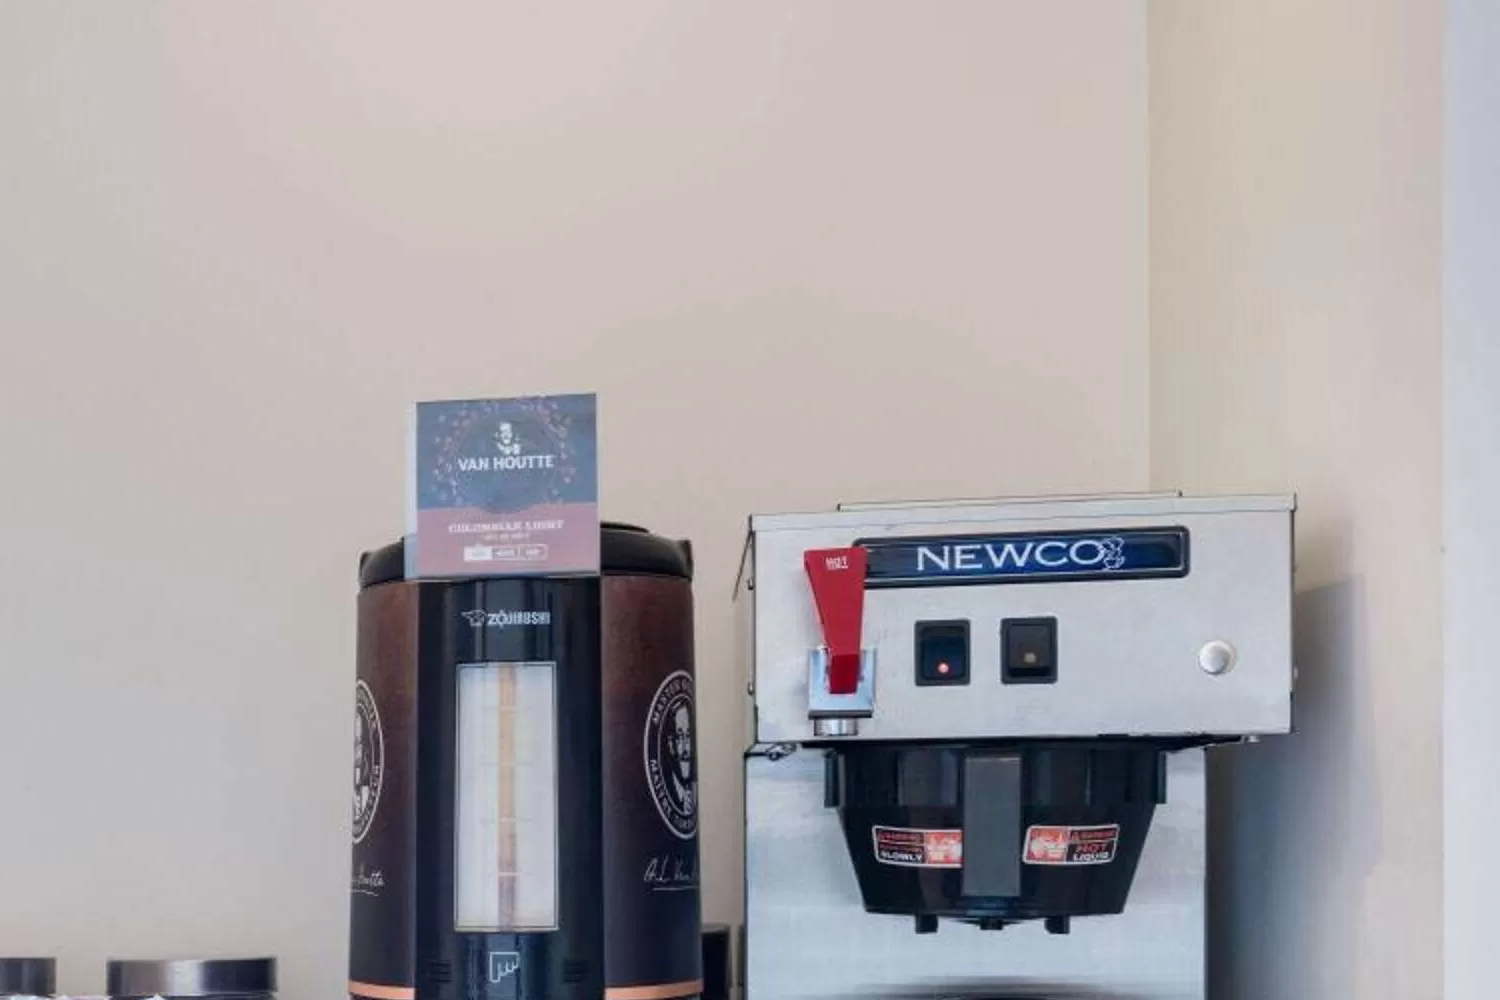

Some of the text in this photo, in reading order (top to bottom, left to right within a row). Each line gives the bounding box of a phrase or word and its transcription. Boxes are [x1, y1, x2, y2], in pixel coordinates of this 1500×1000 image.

[457, 455, 556, 471] VAN HOUTTE
[916, 540, 1105, 571] NEWCO
